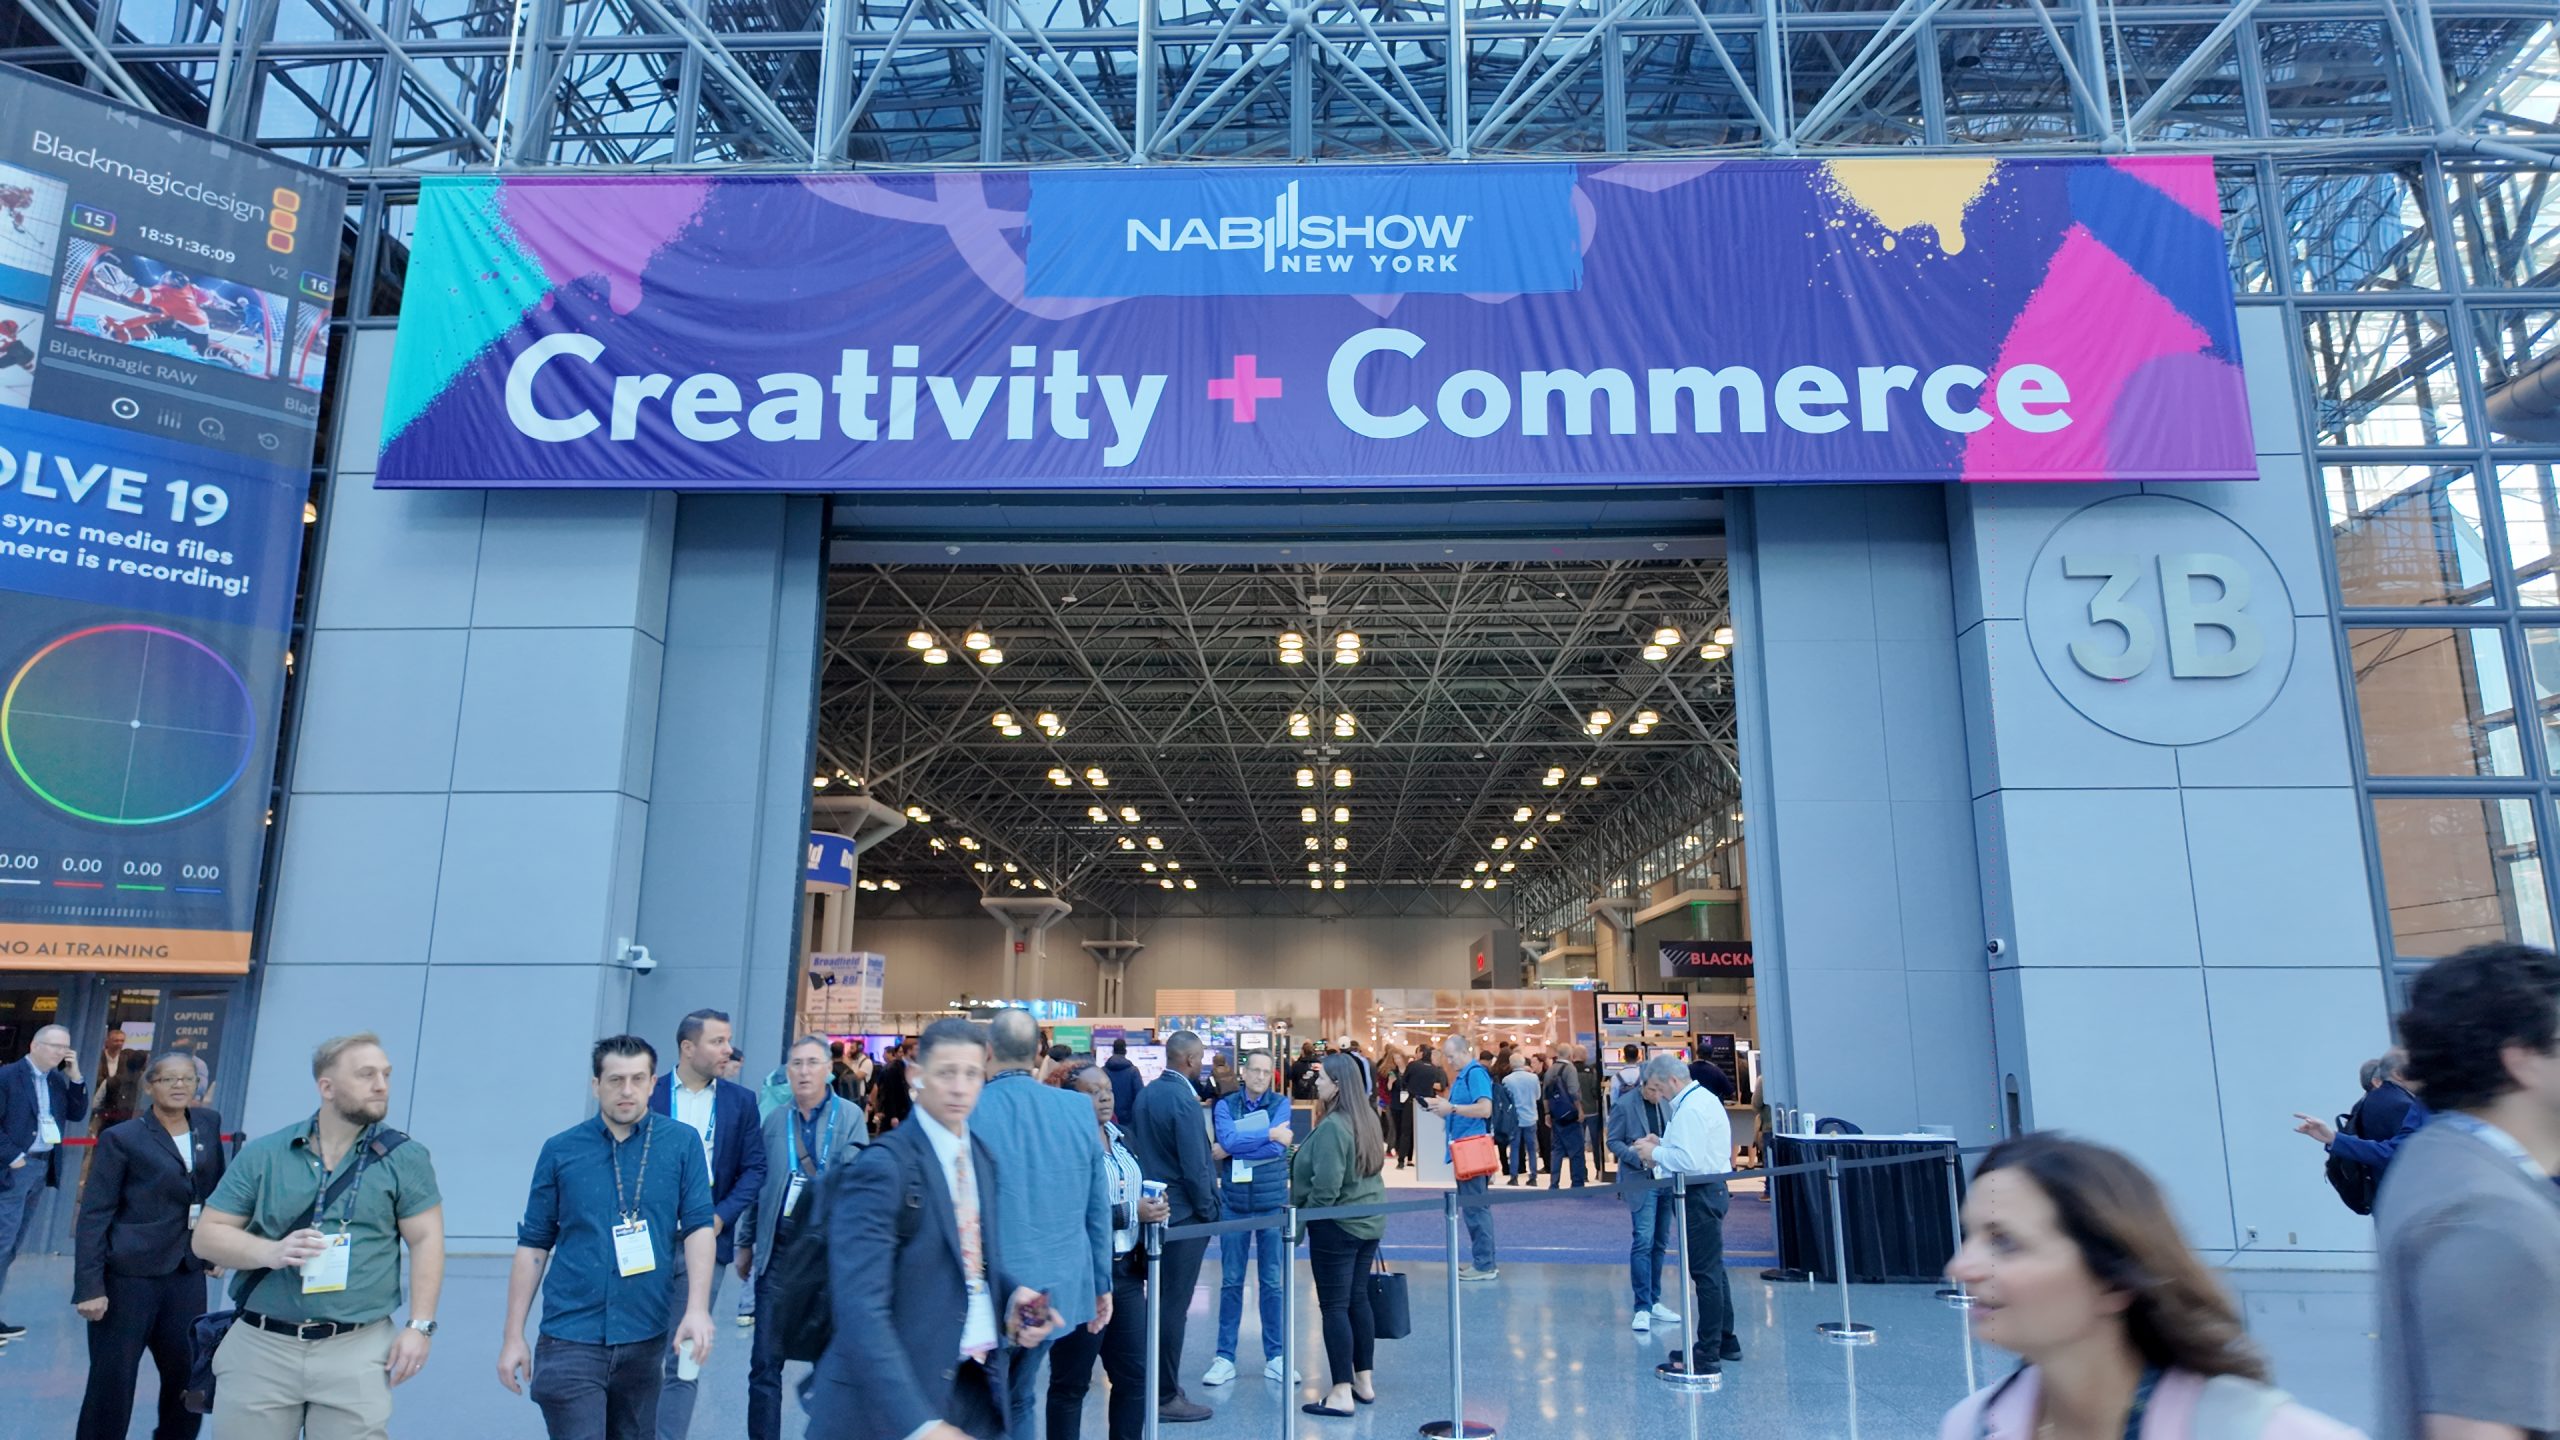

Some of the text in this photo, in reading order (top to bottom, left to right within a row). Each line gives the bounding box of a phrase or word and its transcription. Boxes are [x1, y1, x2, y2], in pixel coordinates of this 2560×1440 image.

[32, 130, 265, 222] Blackmagicdesign
[83, 211, 106, 227] 15
[1126, 216, 1264, 252] NAB
[138, 226, 236, 263] 18:51:36:09
[269, 263, 289, 280] V2
[1281, 254, 1458, 273] NEW YORK
[309, 277, 328, 294] 16
[49, 339, 198, 386] Blackmagic RAW
[505, 332, 1168, 467] Creativity
[1327, 327, 2074, 438] Commerce
[165, 479, 229, 526] 19
[2, 513, 234, 565] sync media files
[77, 547, 100, 569] is
[107, 557, 250, 597] recording!
[2060, 553, 2266, 682] 3B
[62, 857, 103, 873] 0.00
[123, 861, 162, 876] 0.00
[182, 864, 219, 880] 0.00
[35, 941, 58, 955] AI
[65, 942, 169, 958] TRAINING
[174, 1012, 215, 1022] CAPTURE
[175, 1026, 209, 1036] CREATE
